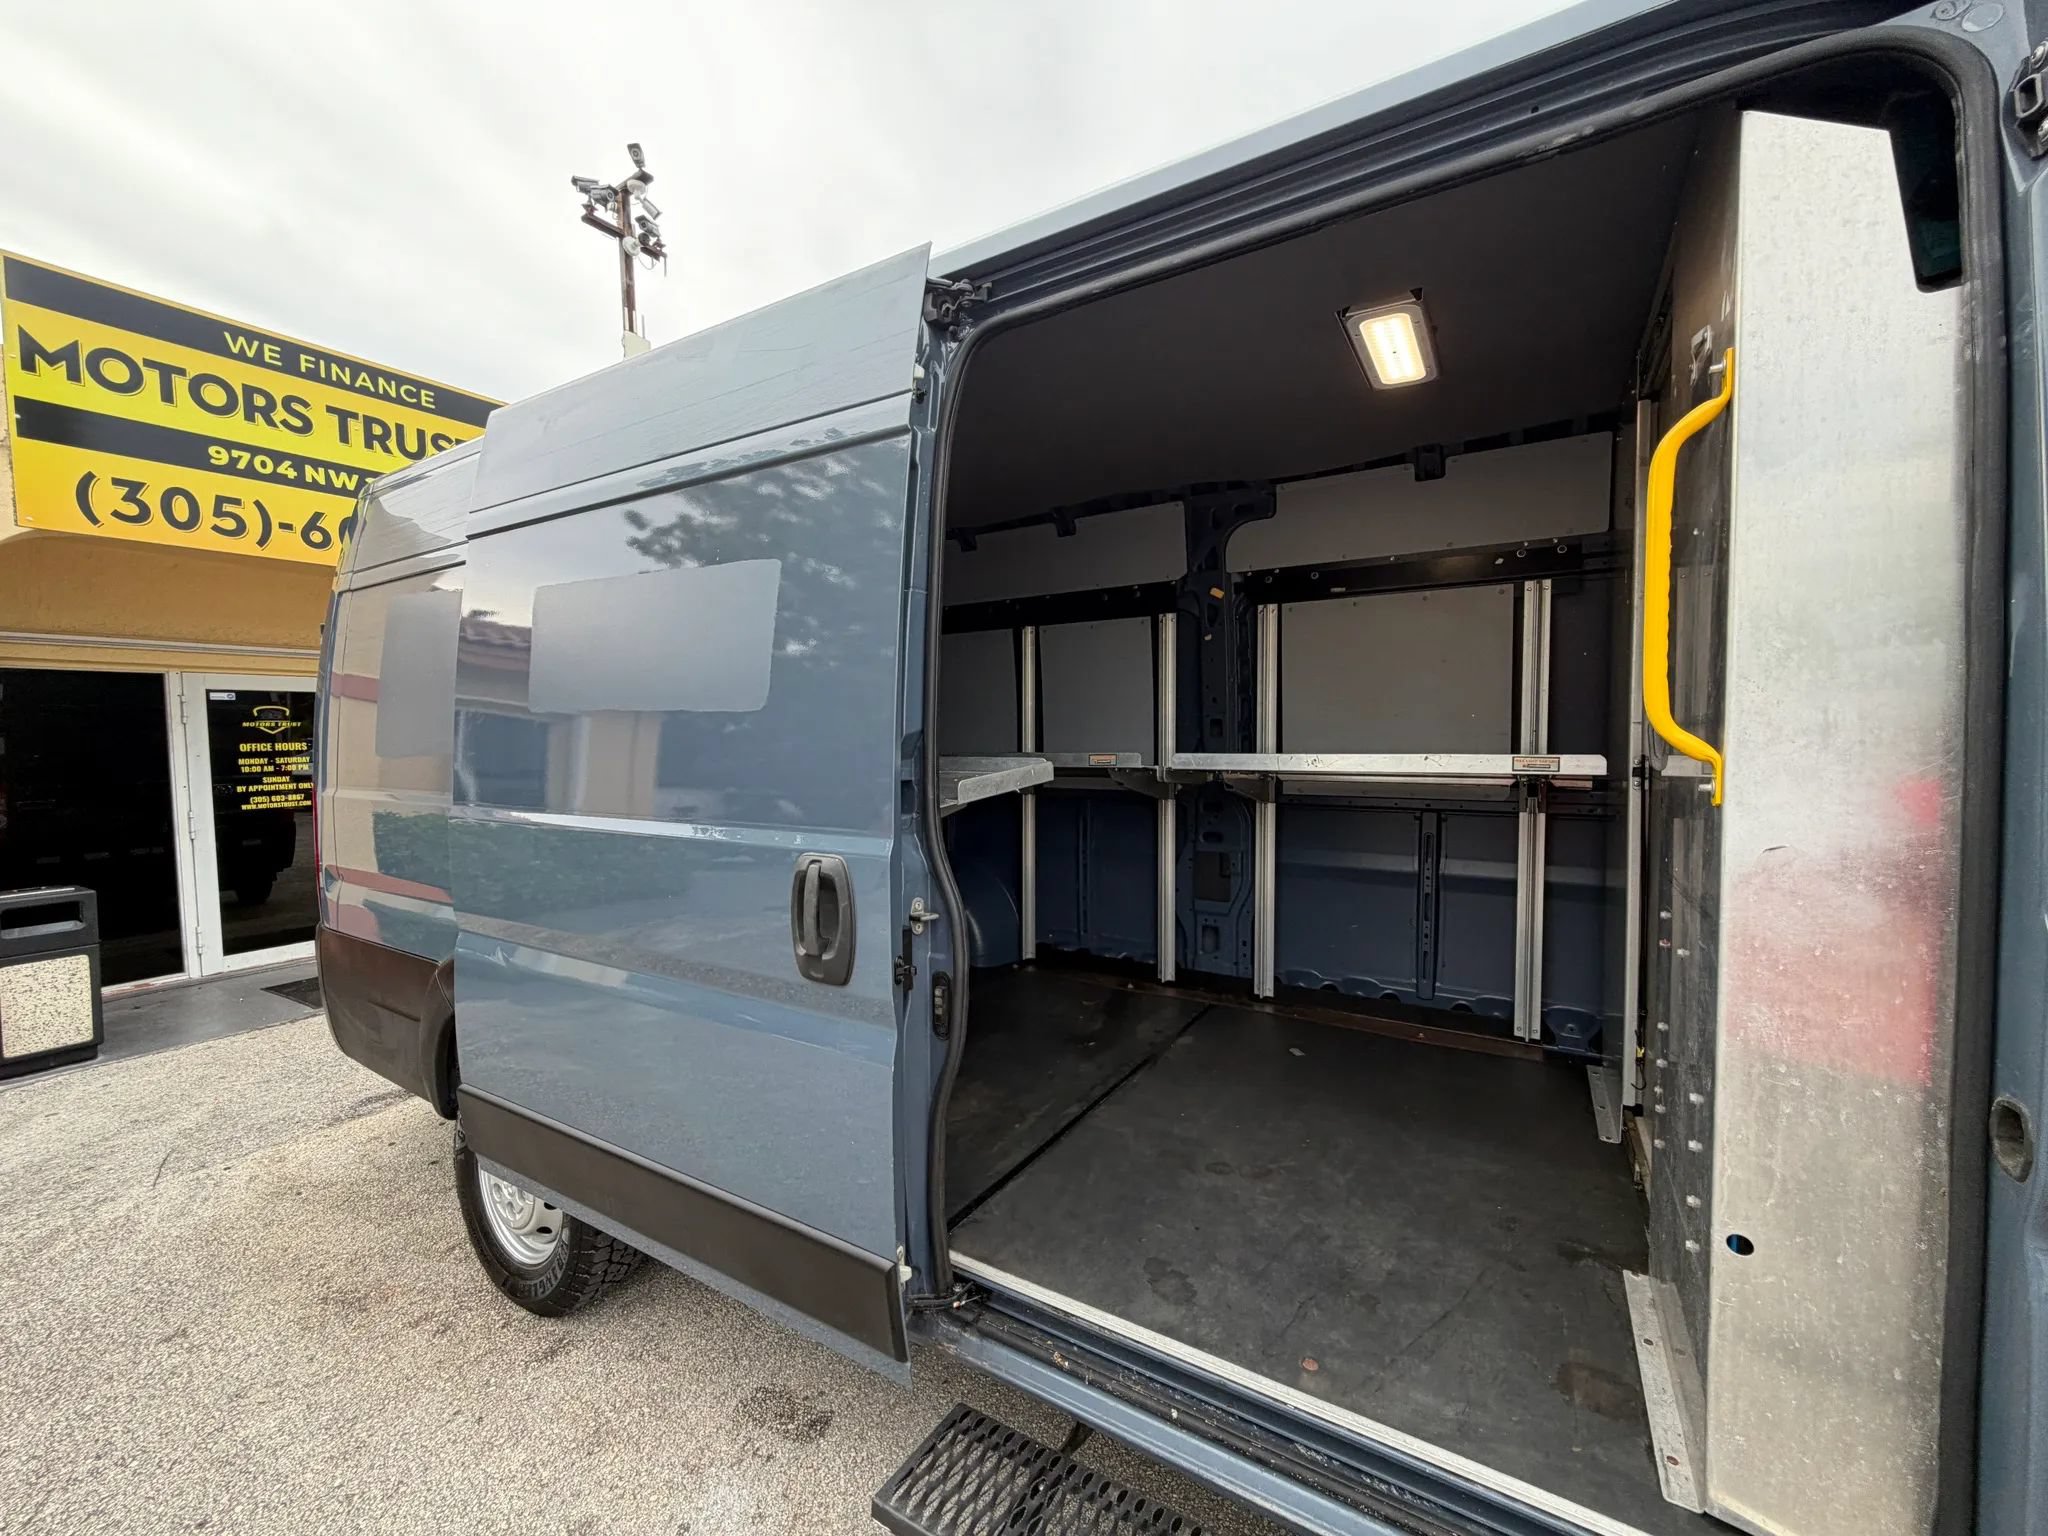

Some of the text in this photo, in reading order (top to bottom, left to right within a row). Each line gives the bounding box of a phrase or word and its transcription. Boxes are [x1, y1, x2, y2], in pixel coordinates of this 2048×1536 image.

[223, 331, 437, 410] WE FINANCE
[18, 325, 314, 438] MOTORS
[208, 445, 360, 491] 9704 NW
[239, 742, 308, 752] OFFICE HOURS
[238, 757, 268, 766] MONDAY
[275, 756, 310, 764] SATURDAY
[241, 765, 261, 773] 10:00
[248, 783, 297, 792] APPOINTMENT
[241, 800, 312, 810] WWW.MOTORSTRUST.COM
[250, 796, 270, 804] (305)
